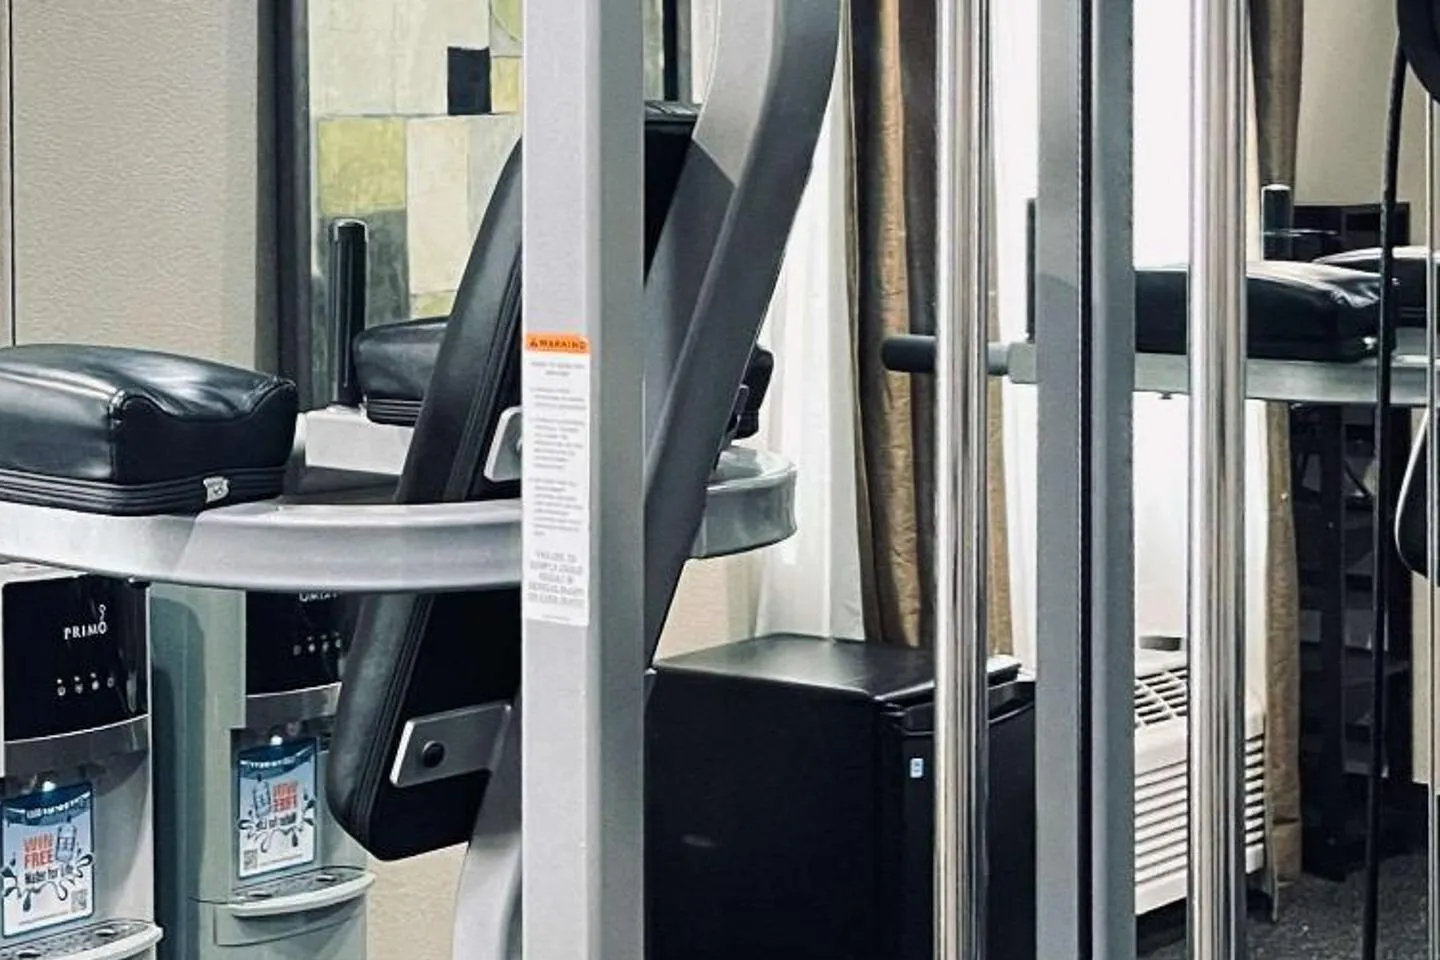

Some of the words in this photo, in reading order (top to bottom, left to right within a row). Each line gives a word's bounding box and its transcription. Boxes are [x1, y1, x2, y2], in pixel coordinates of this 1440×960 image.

[539, 339, 587, 350] WARNING
[64, 621, 107, 640] PRIMO
[24, 849, 54, 869] FREE
